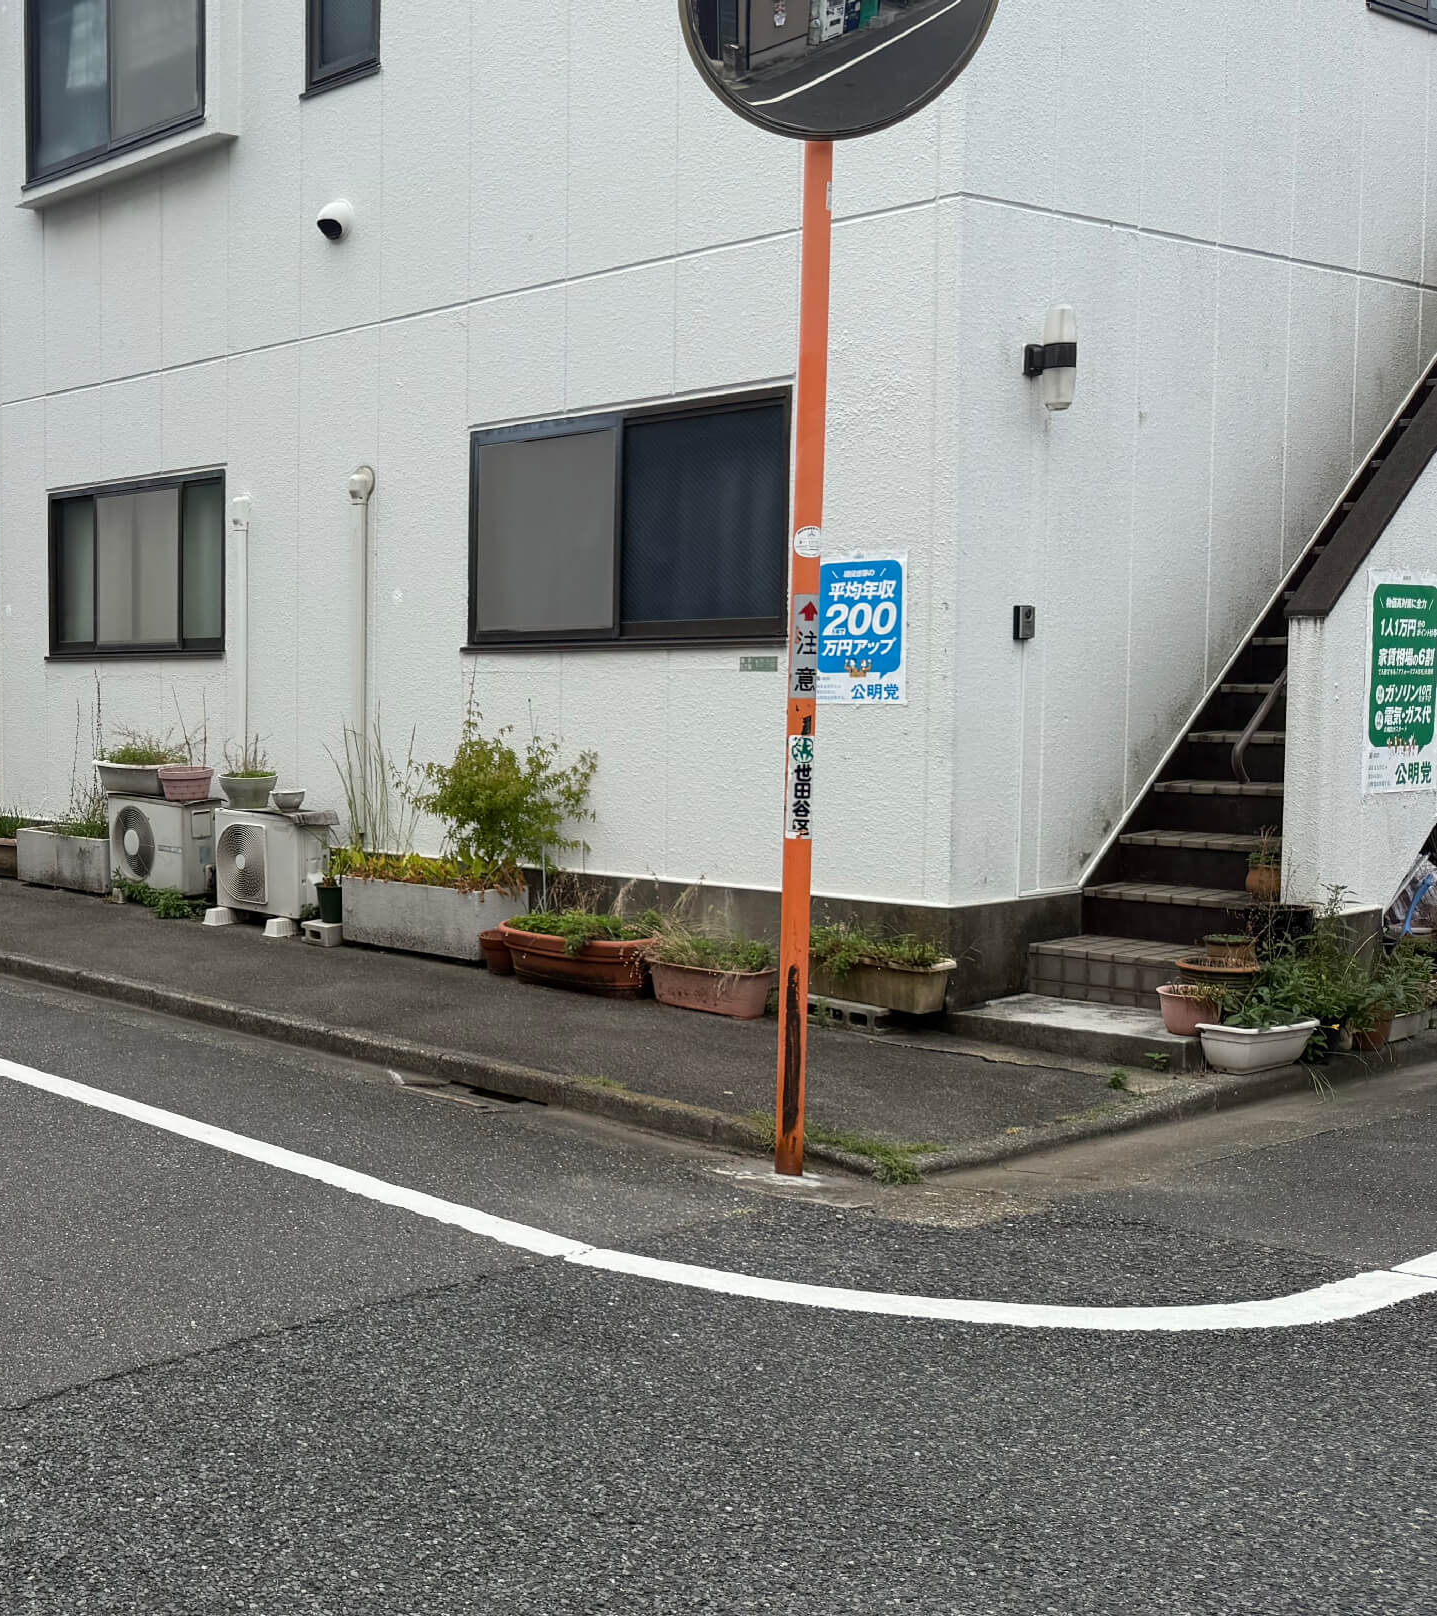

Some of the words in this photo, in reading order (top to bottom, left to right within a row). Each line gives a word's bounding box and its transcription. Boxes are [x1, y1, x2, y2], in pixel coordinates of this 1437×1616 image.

[828, 579, 897, 601] 平均年収
[822, 602, 897, 637] 200
[1381, 618, 1417, 637] 1人1万円
[821, 637, 897, 657] 万円アップ
[794, 630, 817, 692] 注意
[851, 683, 900, 700] 公明党
[1384, 683, 1420, 703] ガソリン
[1384, 705, 1432, 726] 電気・ガス代
[1395, 760, 1432, 785] 公明党
[792, 764, 813, 836] 世田谷区
